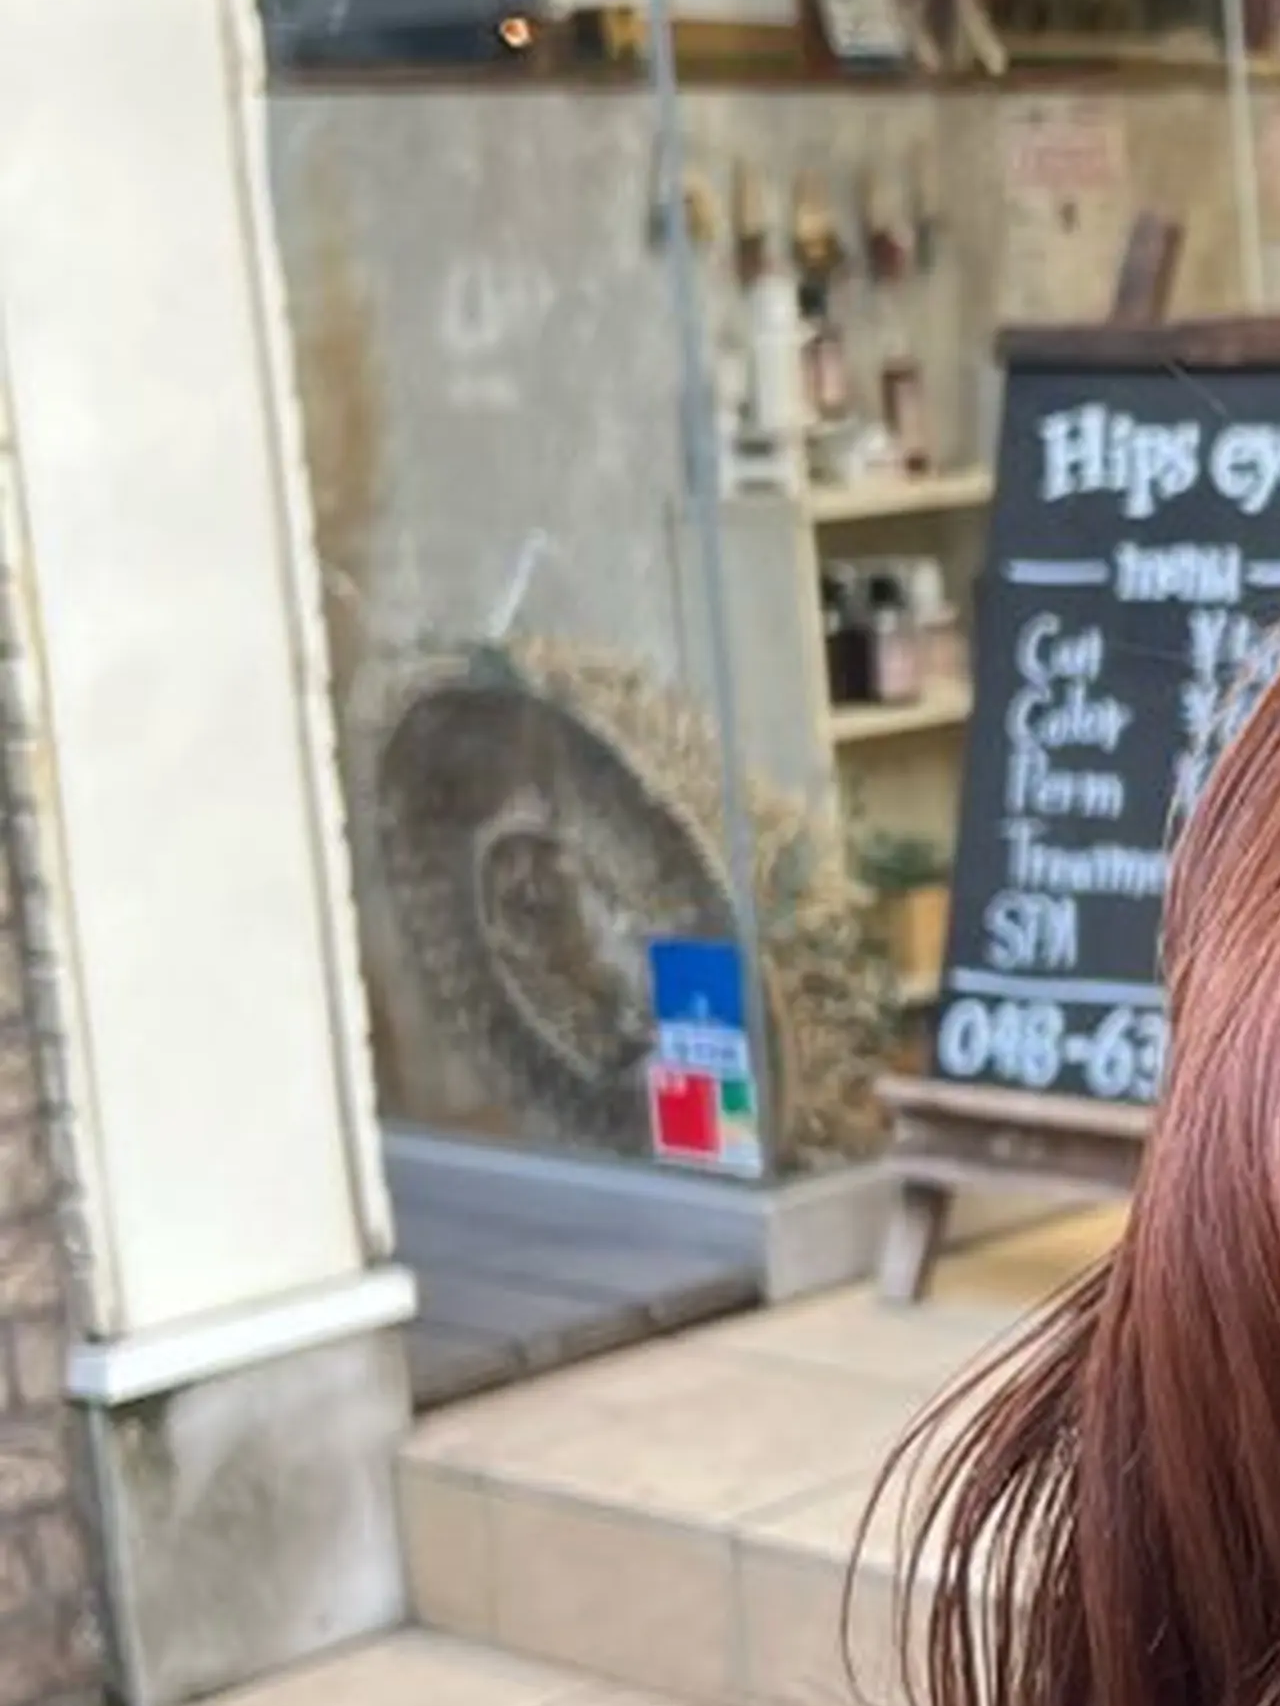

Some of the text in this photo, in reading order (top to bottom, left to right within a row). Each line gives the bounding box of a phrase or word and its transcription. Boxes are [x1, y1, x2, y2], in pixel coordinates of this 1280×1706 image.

[1038, 403, 1199, 519] Hips
[1005, 681, 1133, 763] Color
[1004, 745, 1124, 821] Perm
